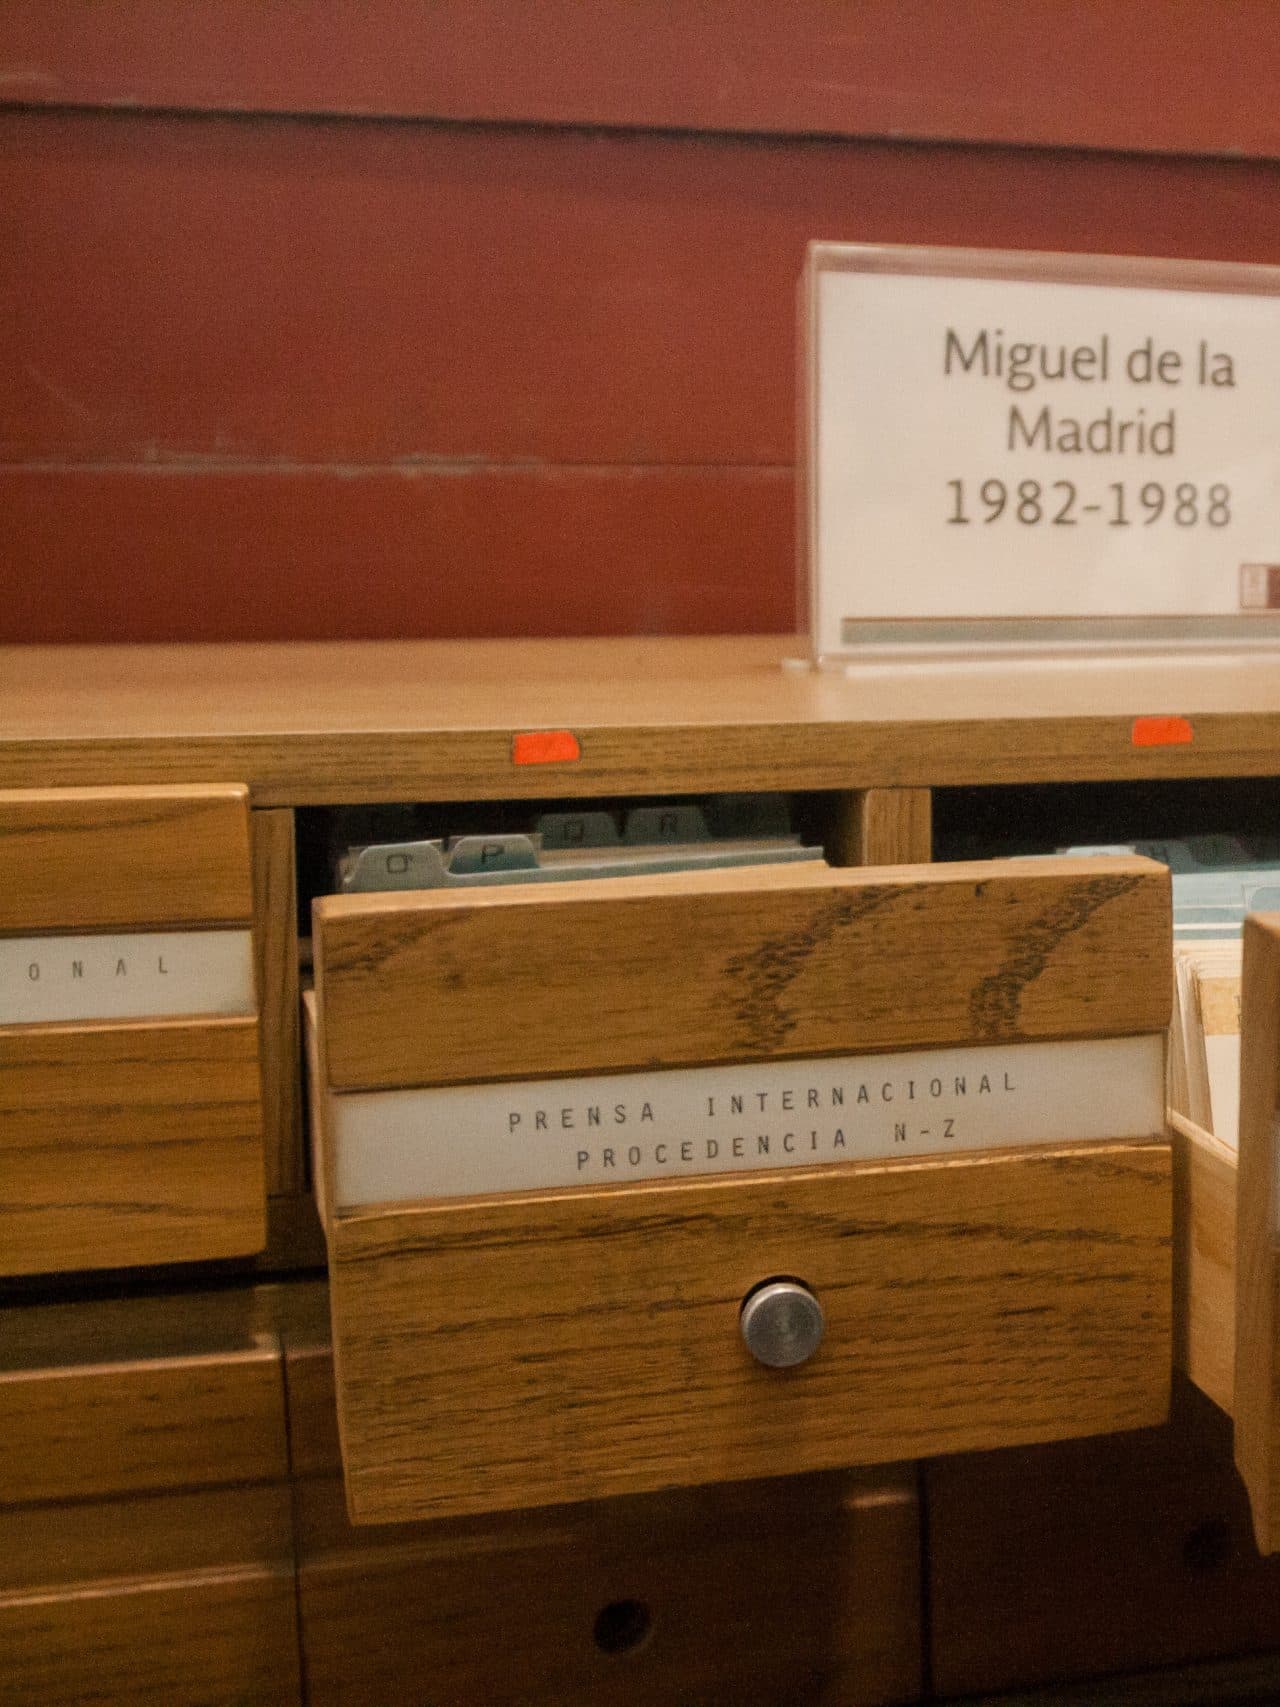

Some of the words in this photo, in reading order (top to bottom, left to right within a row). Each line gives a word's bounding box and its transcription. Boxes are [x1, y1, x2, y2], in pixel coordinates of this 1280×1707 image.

[943, 327, 1109, 391] Miguel
[1126, 337, 1183, 384] de
[1199, 340, 1237, 388] la
[1006, 405, 1177, 457] Madrid
[945, 478, 1233, 527] 1982-1988
[481, 844, 505, 864] P
[507, 1101, 655, 1134] PRENSA
[707, 1071, 1018, 1117] INTERNACIONAL
[576, 1128, 848, 1172] PROCEDENCIA
[894, 1118, 957, 1143] N-Z
